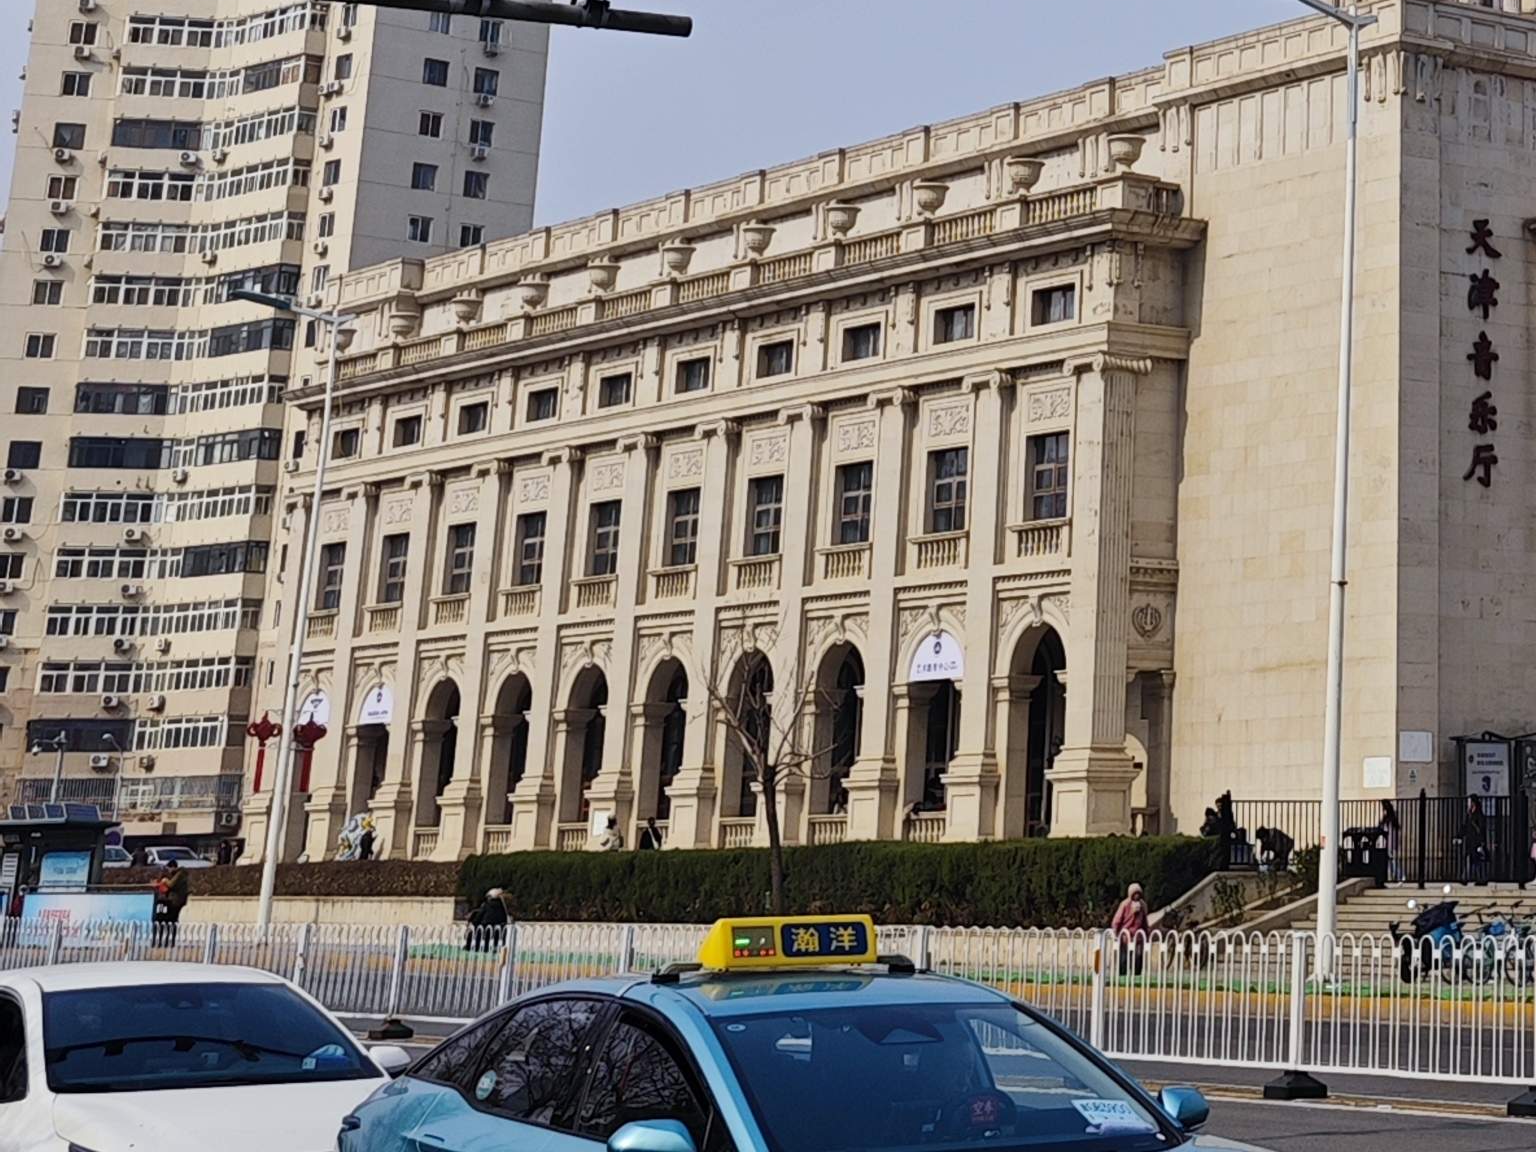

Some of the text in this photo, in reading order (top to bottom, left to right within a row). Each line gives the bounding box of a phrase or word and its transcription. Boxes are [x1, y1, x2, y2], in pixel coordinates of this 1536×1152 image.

[1463, 219, 1502, 487] 天津音乐厅
[791, 926, 857, 952] 瀚洋
